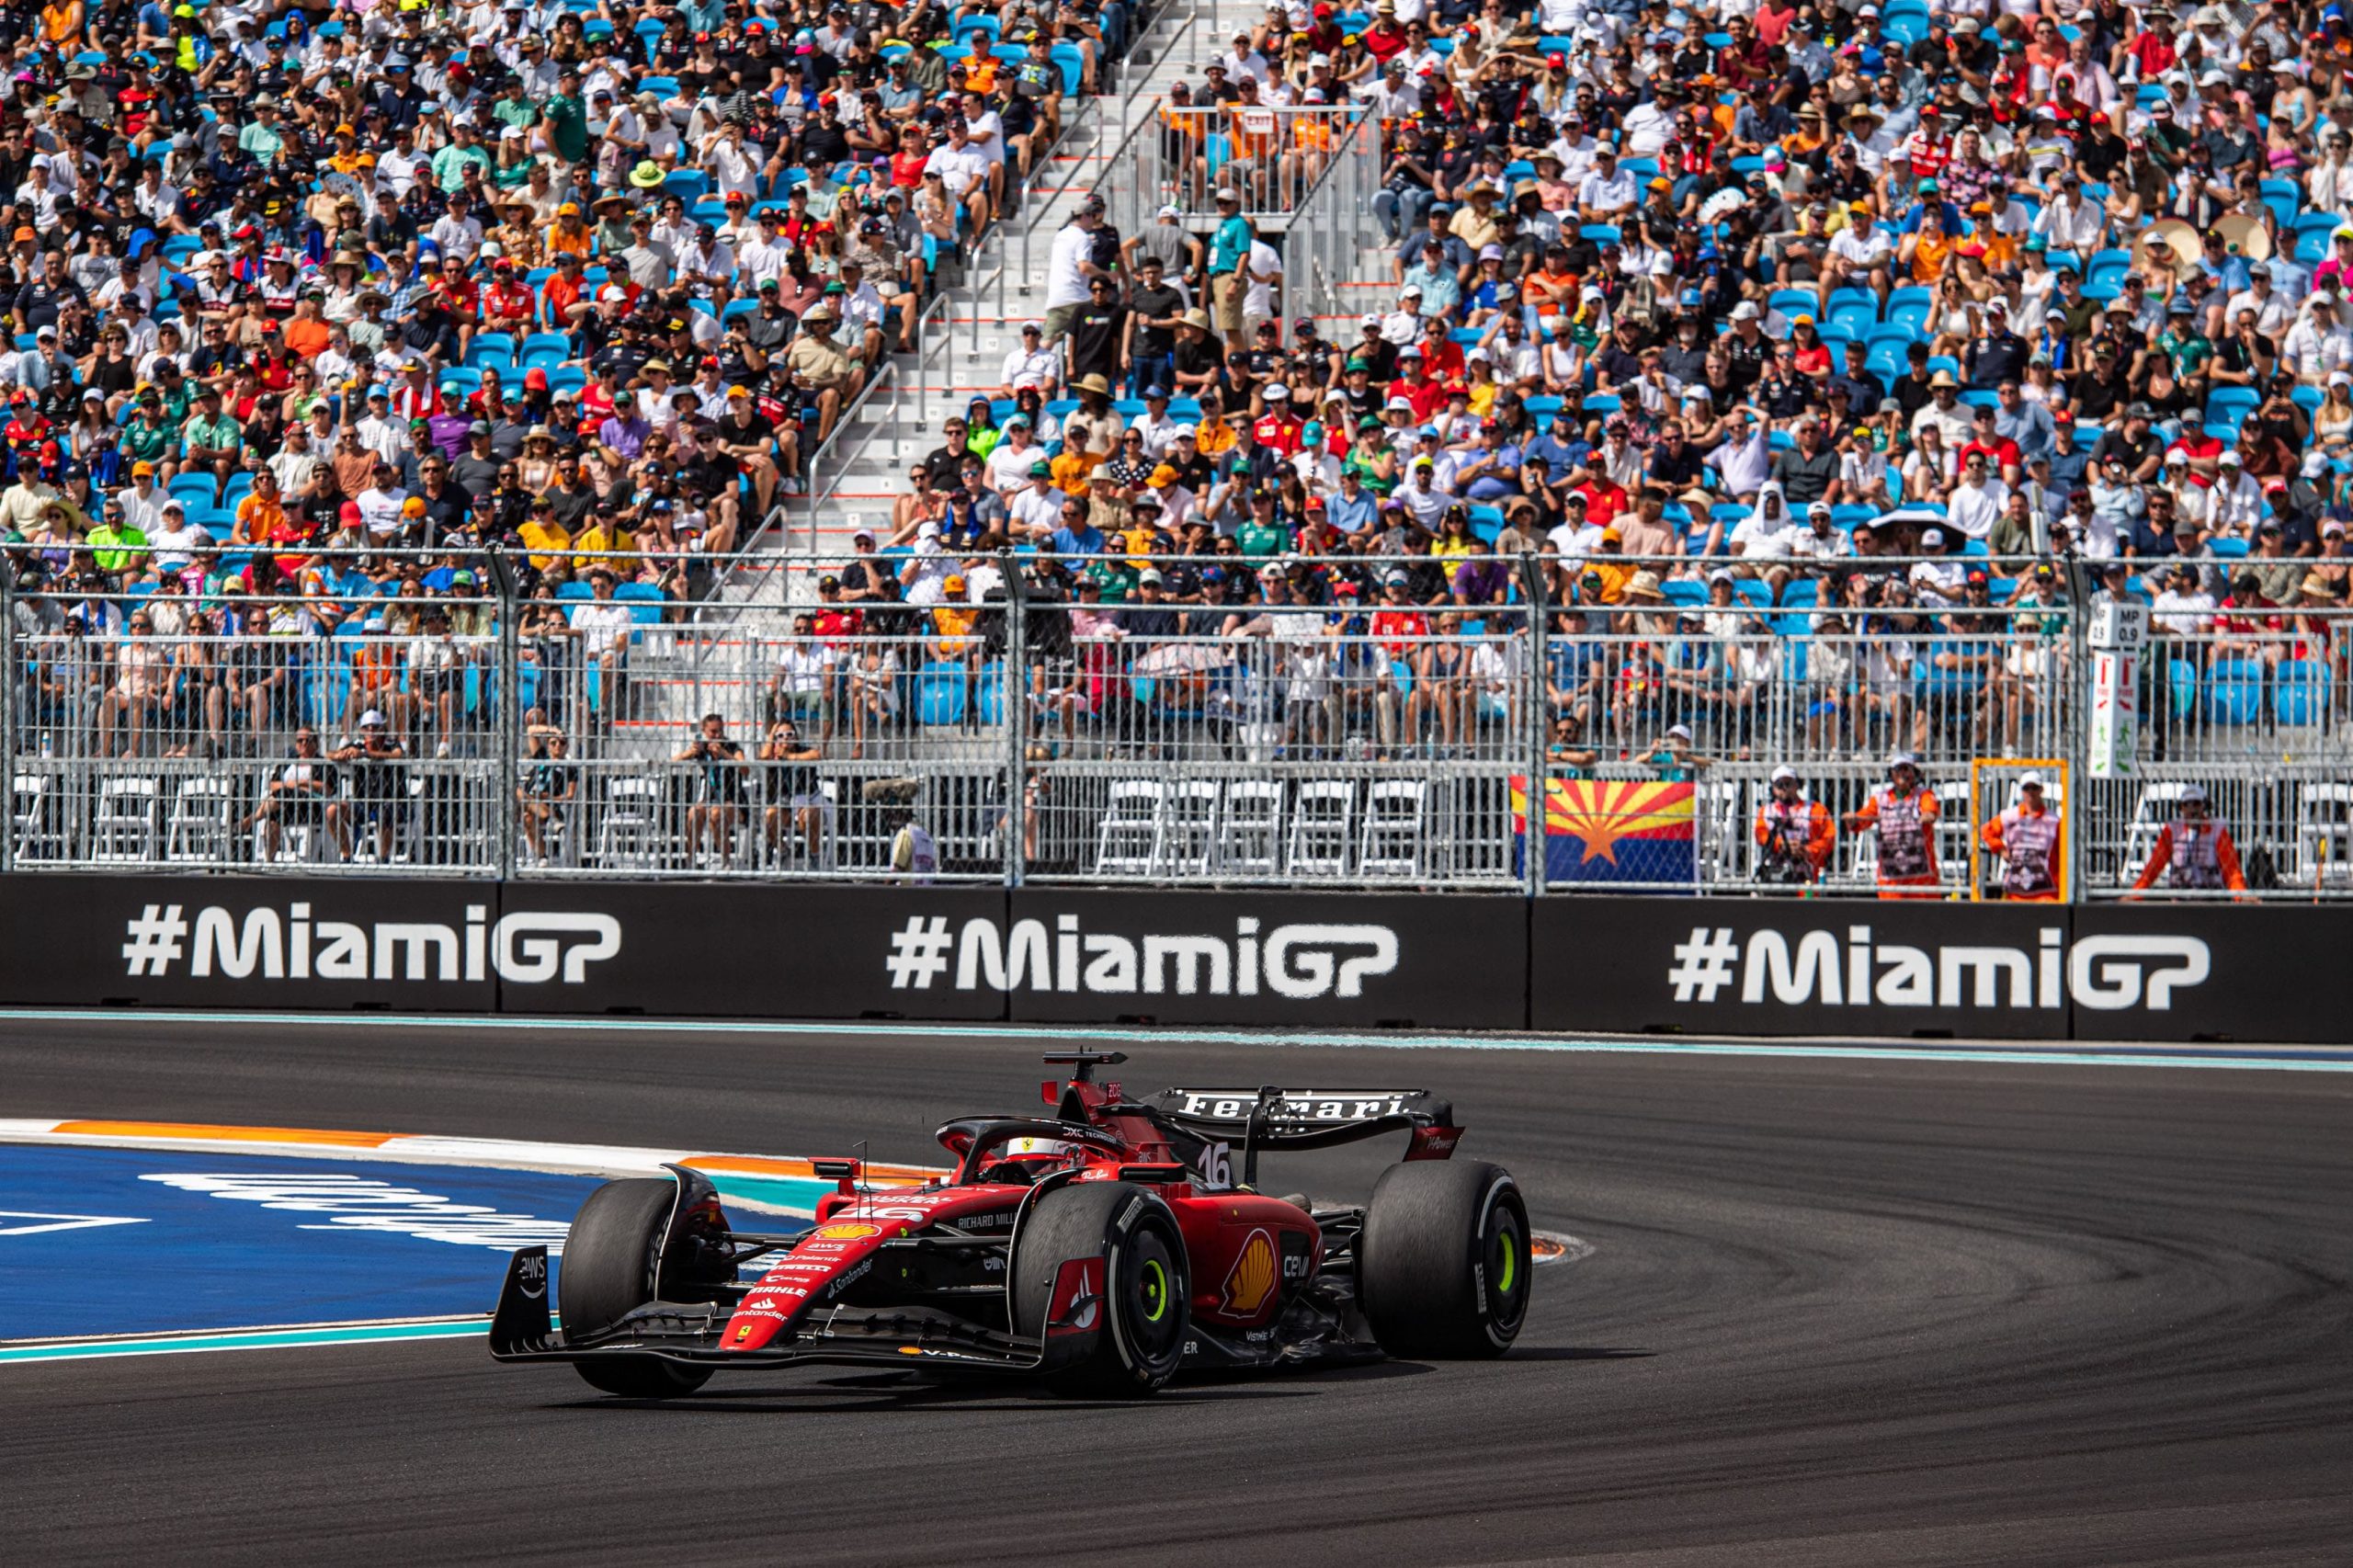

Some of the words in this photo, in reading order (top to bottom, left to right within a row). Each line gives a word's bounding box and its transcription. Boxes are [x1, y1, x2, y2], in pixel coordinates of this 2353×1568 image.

[2120, 609, 2140, 624] MP
[2119, 628, 2138, 642] 0.9
[122, 902, 621, 983] #MiamiGP
[887, 914, 1399, 998] #MiamiGP
[1668, 924, 2211, 1010] #MiamiGP
[1198, 1142, 1232, 1189] 16
[959, 1216, 994, 1229] RICHARD
[746, 1286, 808, 1298] MAHLE
[835, 1258, 872, 1294] Santander
